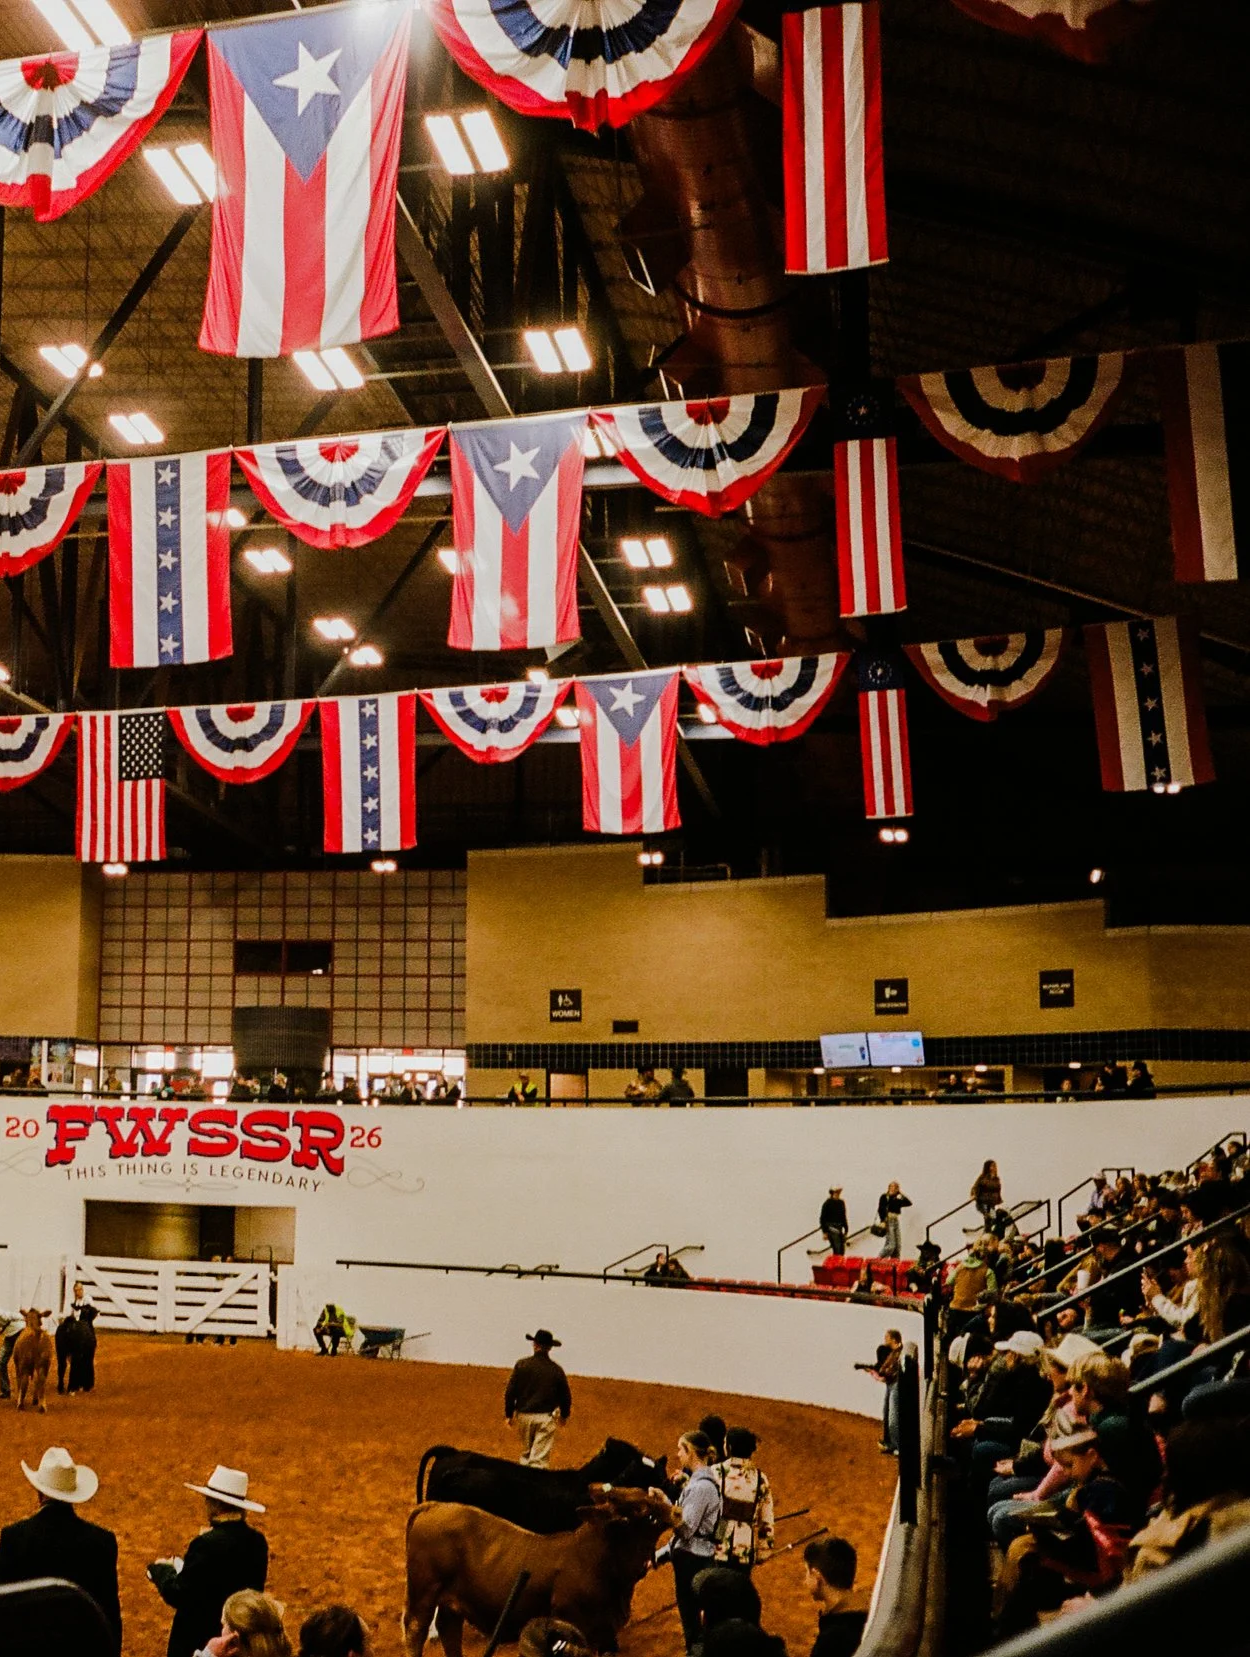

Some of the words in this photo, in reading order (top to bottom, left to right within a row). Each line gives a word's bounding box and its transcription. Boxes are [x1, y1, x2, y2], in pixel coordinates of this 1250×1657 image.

[551, 1009, 580, 1018] WOMEN
[5, 1116, 40, 1139] 20
[45, 1104, 345, 1177] FWSSR
[350, 1126, 382, 1149] 26
[64, 1165, 106, 1181] THIS
[117, 1162, 172, 1176] THING
[182, 1163, 199, 1176] IS
[209, 1164, 322, 1193] LEGENDARY
